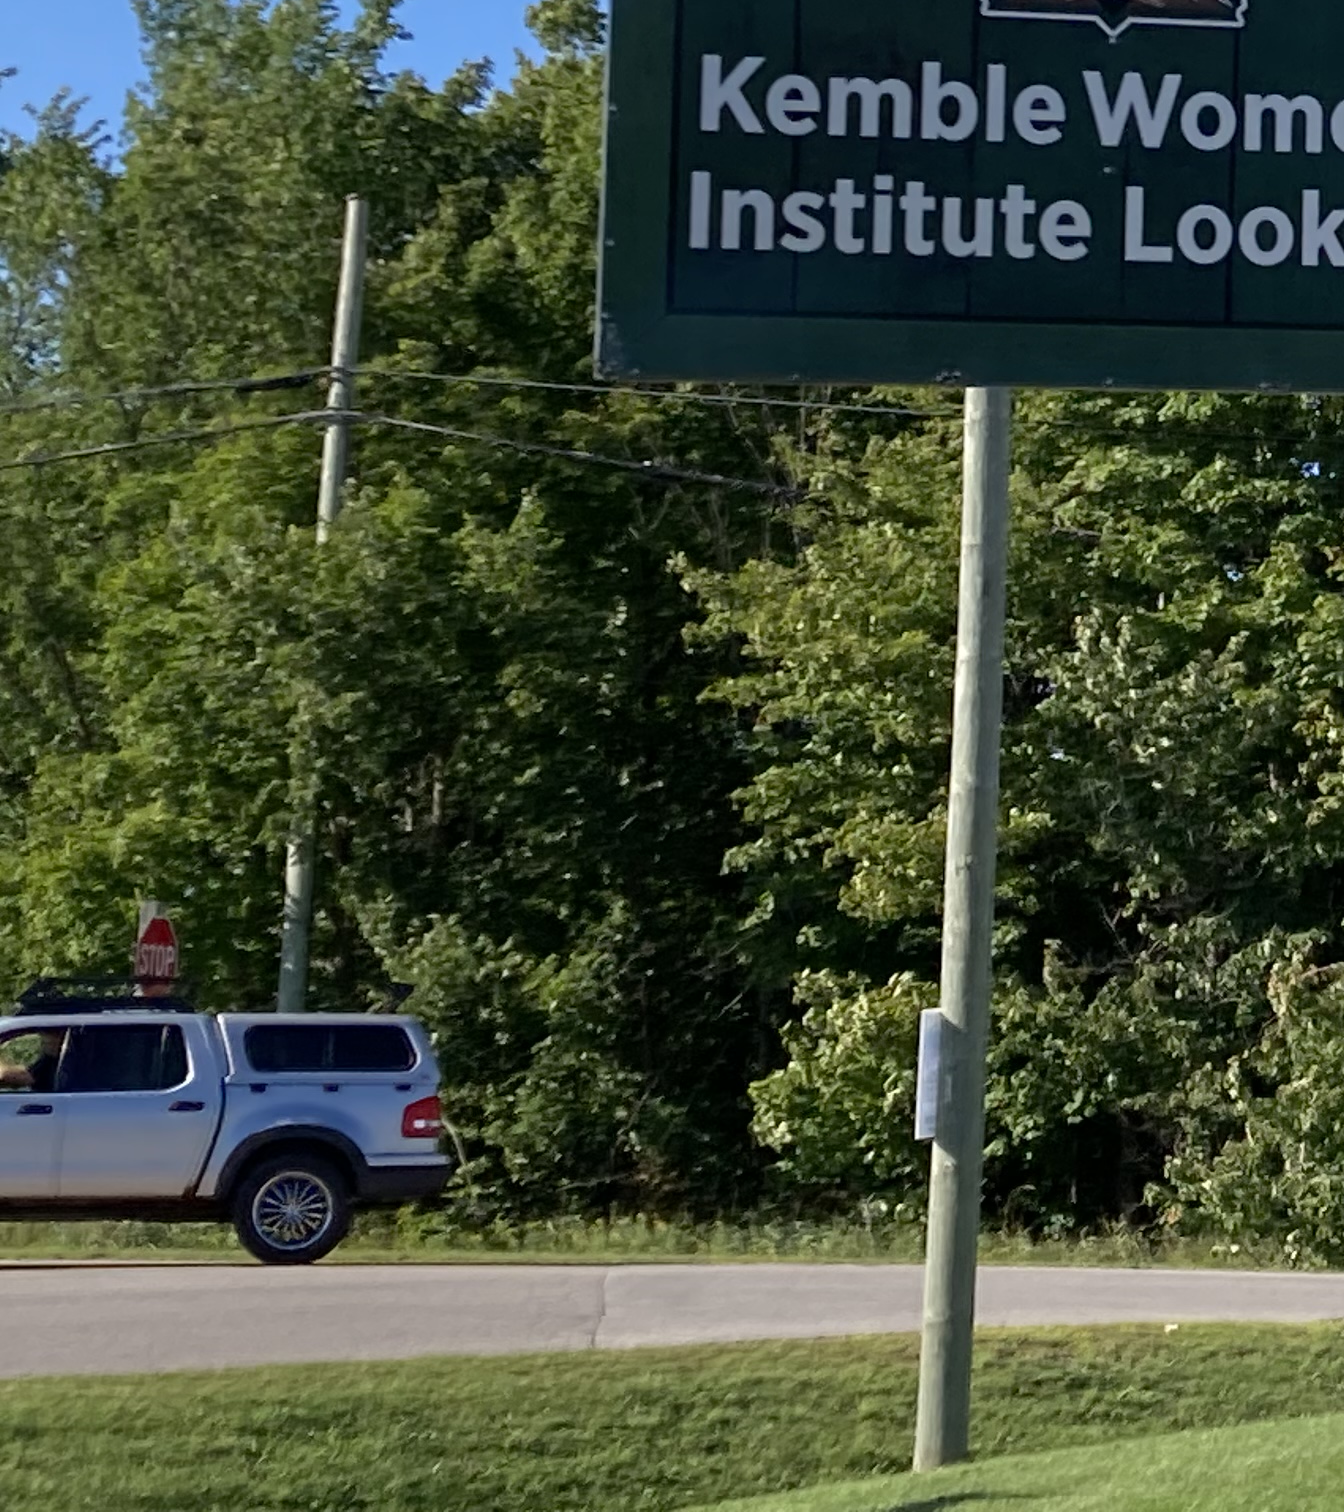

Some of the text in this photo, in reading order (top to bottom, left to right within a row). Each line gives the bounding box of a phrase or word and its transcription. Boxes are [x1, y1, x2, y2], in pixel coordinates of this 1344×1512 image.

[699, 54, 1066, 145] Kemble
[688, 170, 1093, 261] Institute
[139, 943, 175, 977] STOP
